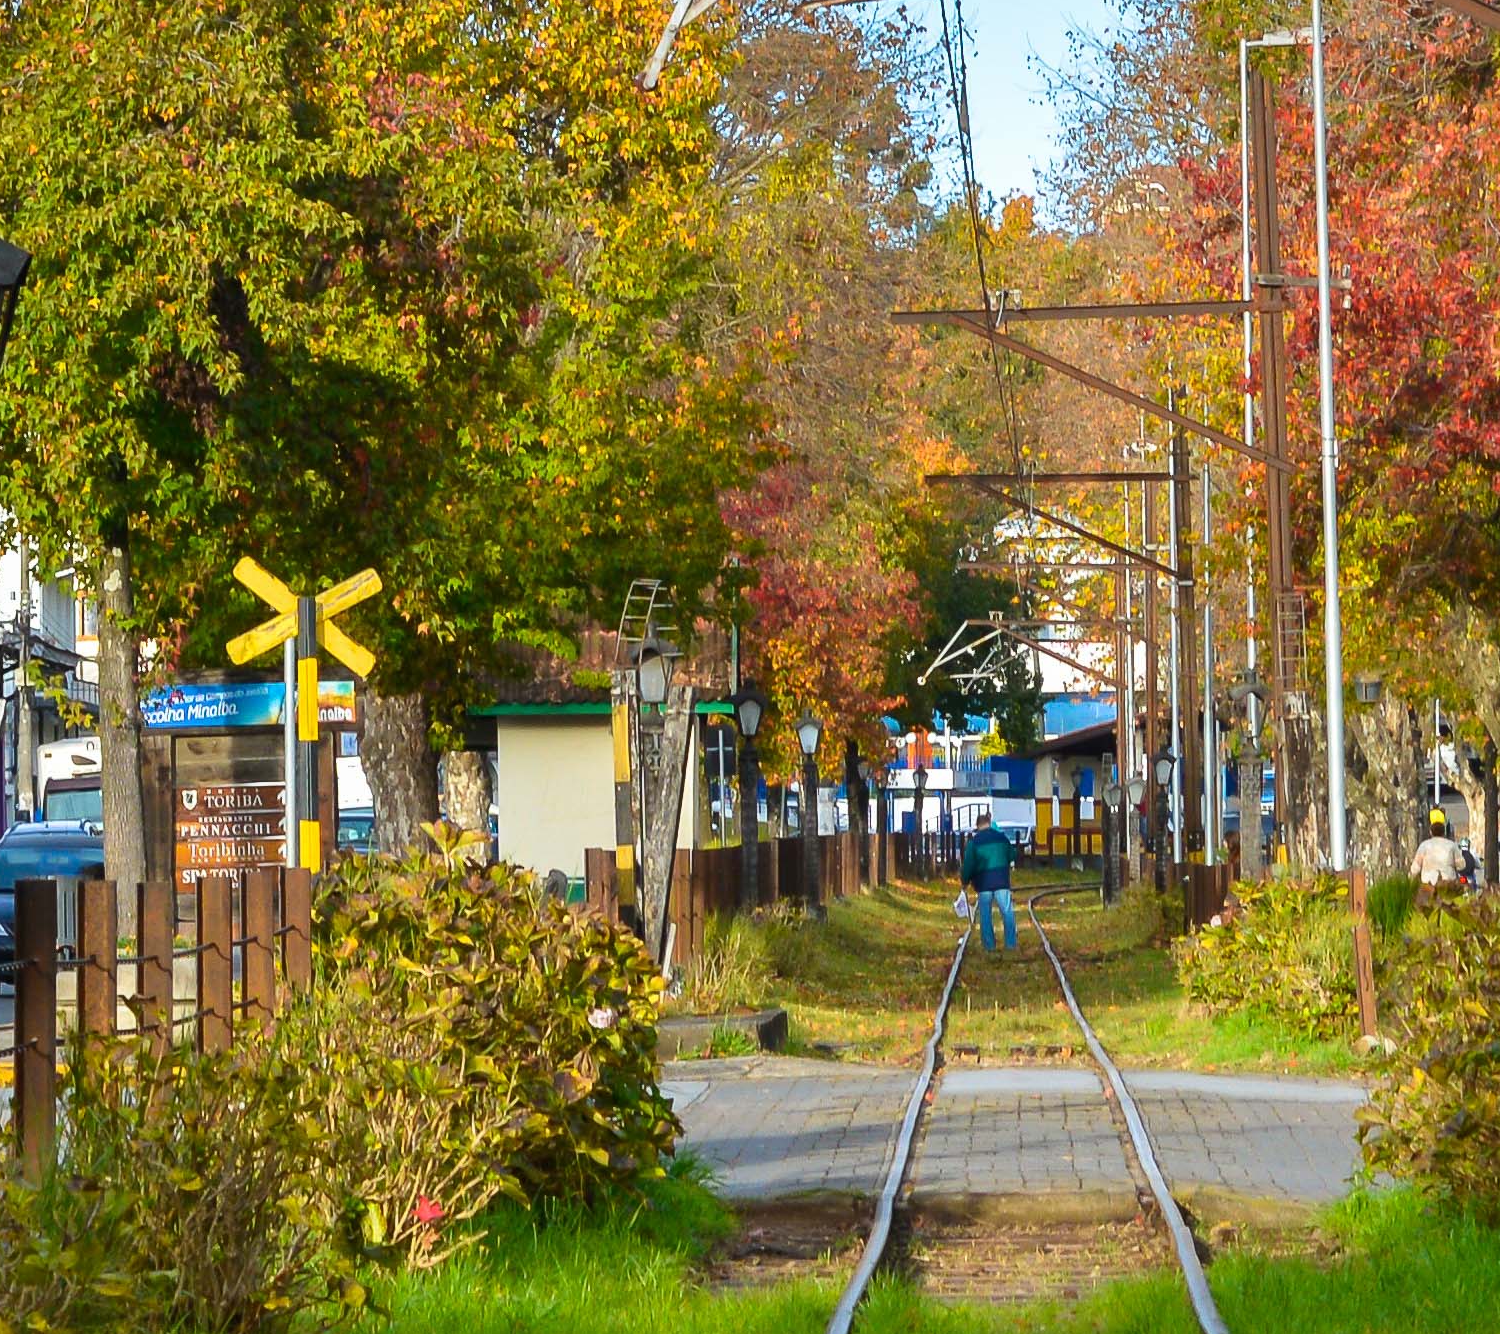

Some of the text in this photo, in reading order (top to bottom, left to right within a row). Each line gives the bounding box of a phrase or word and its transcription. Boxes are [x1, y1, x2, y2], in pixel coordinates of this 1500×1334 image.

[204, 794, 263, 808] TORIBA
[180, 823, 271, 837] PENNACCHI
[188, 841, 265, 857] Toribinha
